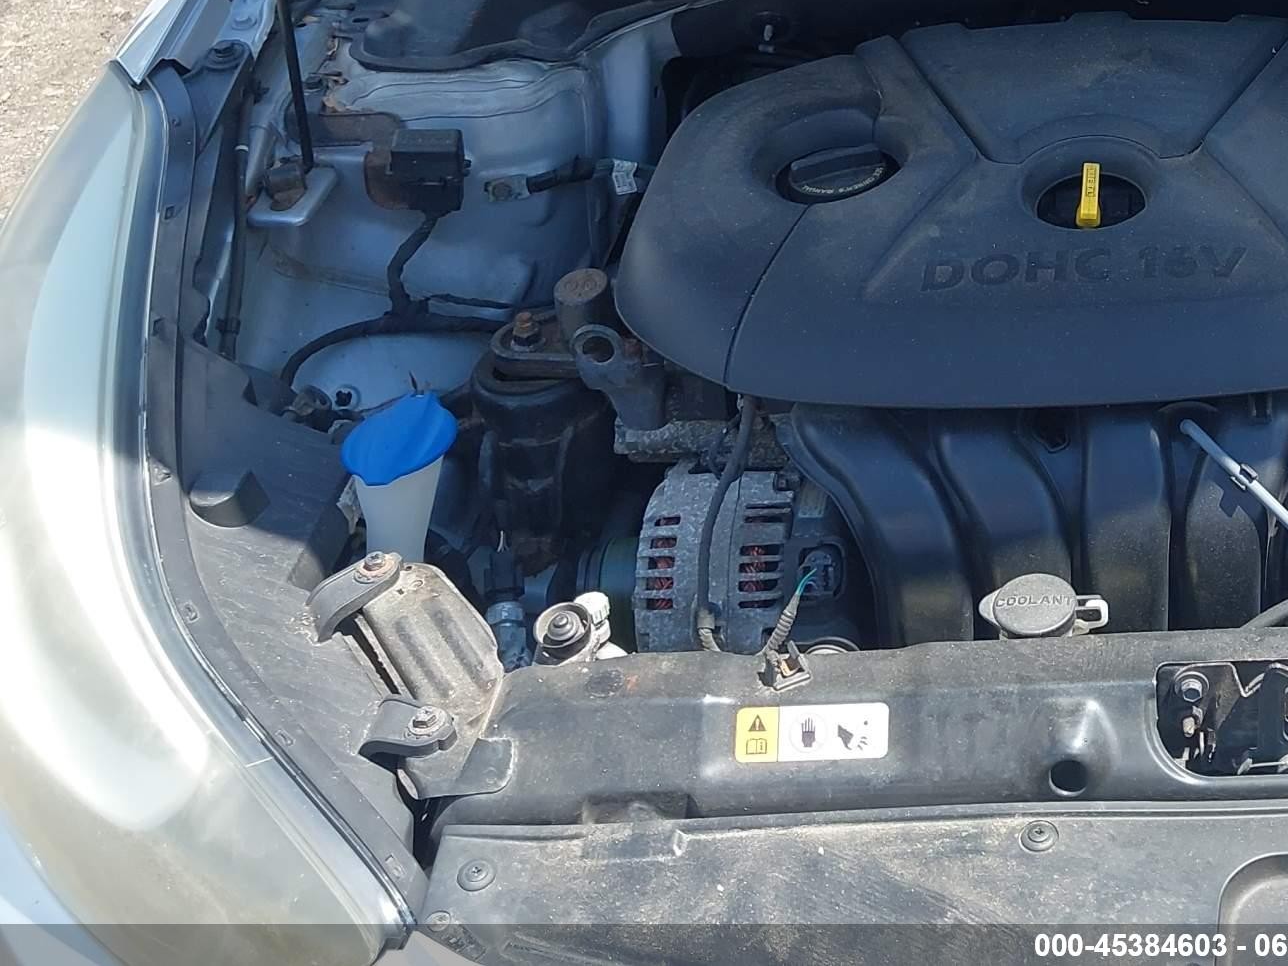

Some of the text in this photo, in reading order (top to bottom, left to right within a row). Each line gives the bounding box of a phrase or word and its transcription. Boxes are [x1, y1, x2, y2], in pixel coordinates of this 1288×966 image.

[919, 245, 1248, 292] DOHC 16V
[995, 595, 1072, 607] COOLANT
